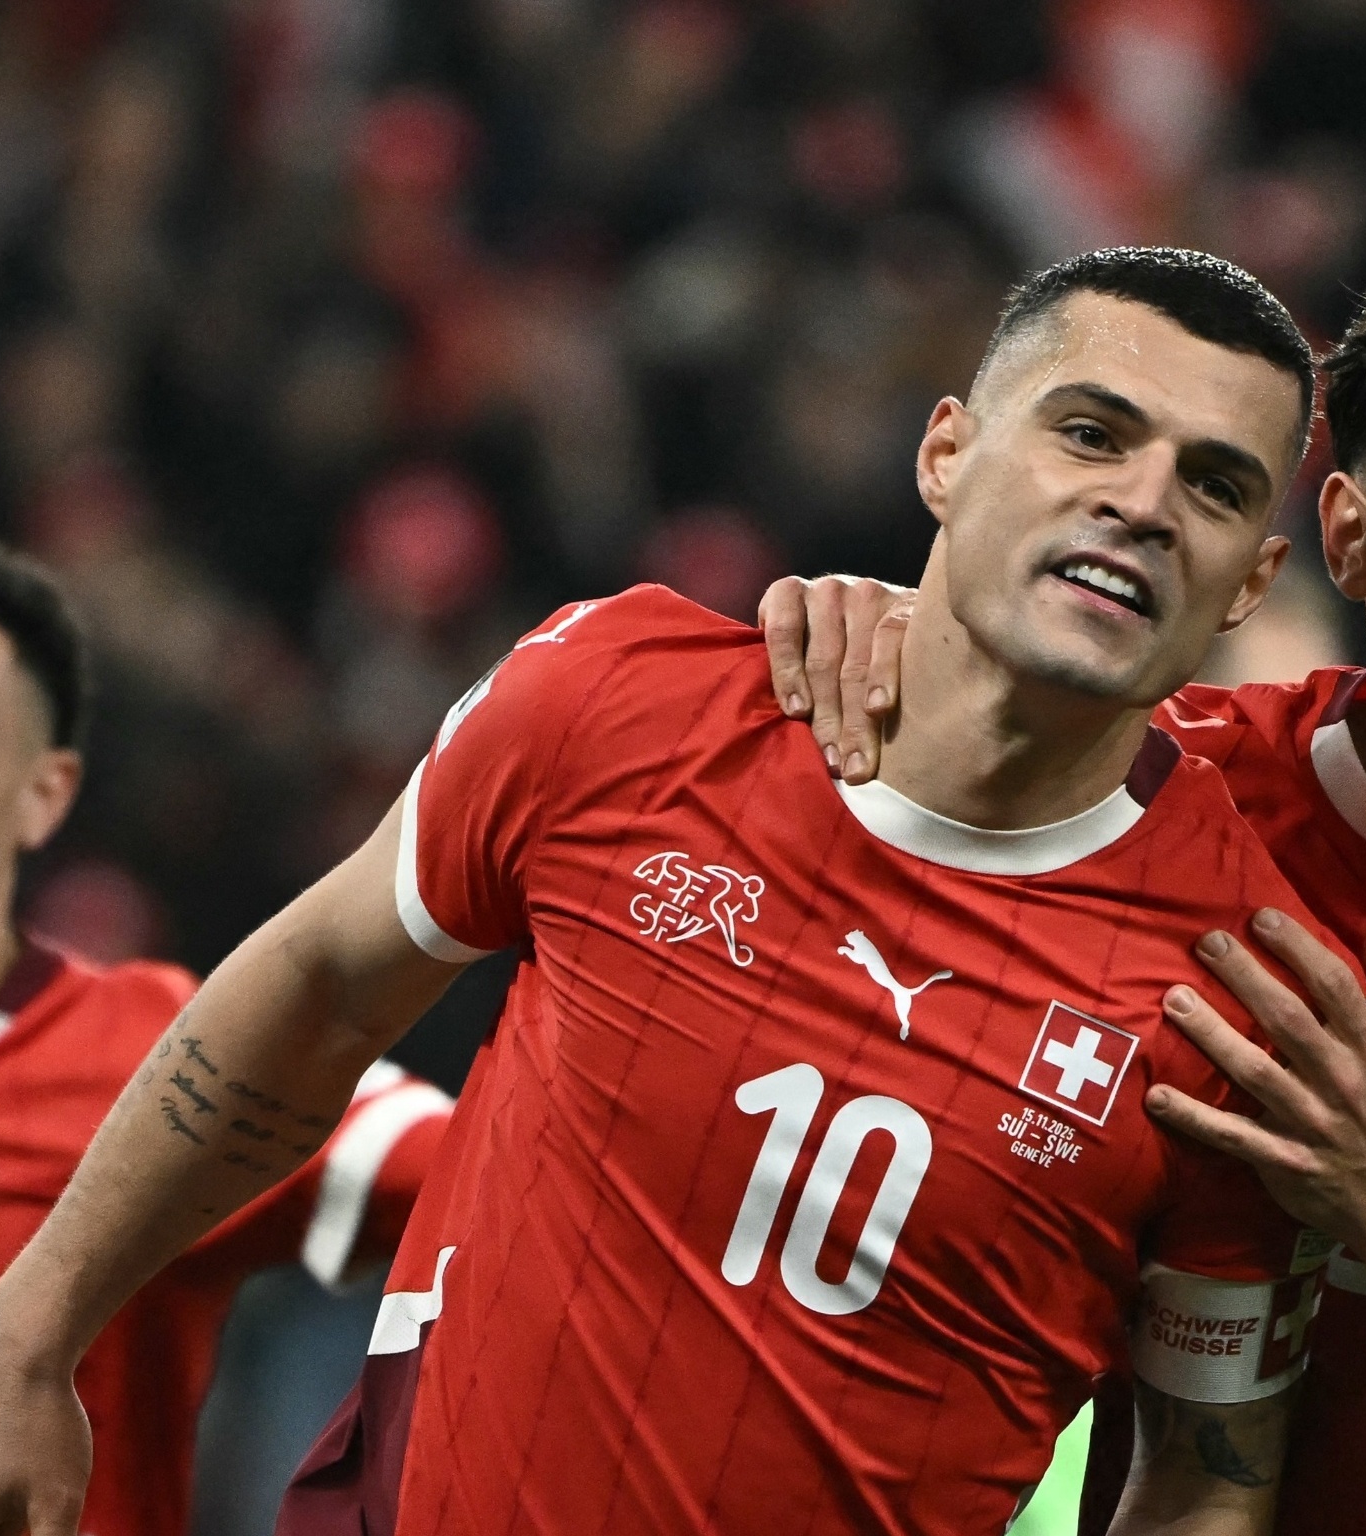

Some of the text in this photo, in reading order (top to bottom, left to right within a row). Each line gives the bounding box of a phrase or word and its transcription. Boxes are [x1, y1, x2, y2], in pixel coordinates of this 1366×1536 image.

[997, 1112, 1028, 1140] SUI
[1043, 1134, 1083, 1164] SWE
[1021, 1107, 1076, 1141] 15.11.2025
[1010, 1140, 1055, 1169] GENEVE
[721, 1062, 933, 1316] 10
[1146, 1300, 1261, 1337] SCHWEIZ
[1149, 1322, 1244, 1357] SUISSE
